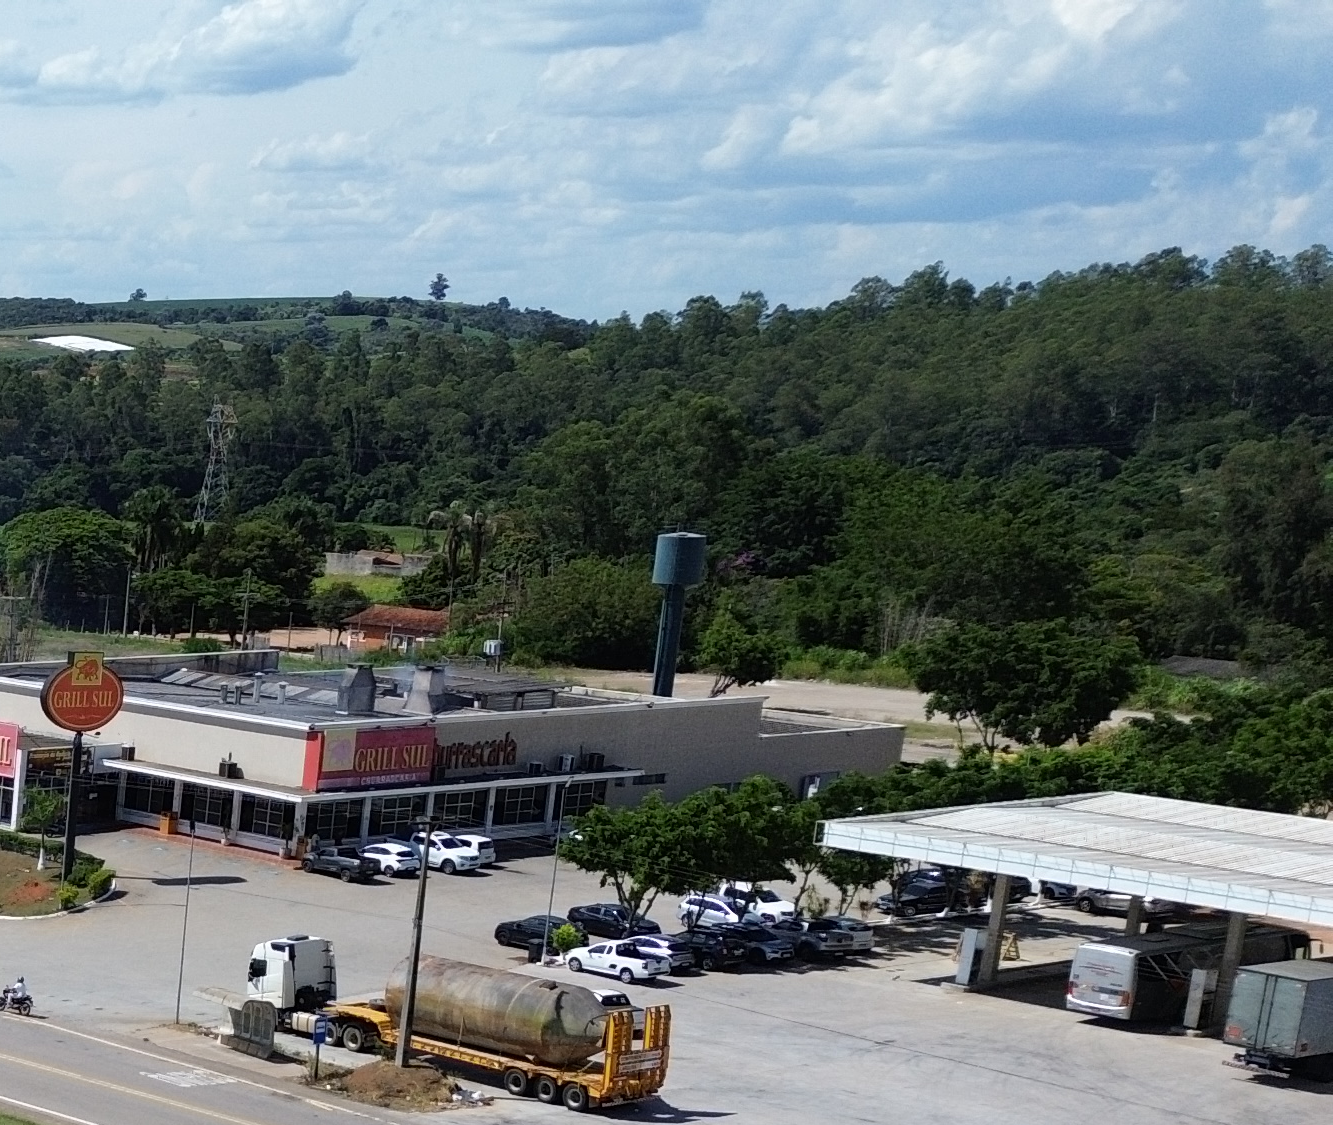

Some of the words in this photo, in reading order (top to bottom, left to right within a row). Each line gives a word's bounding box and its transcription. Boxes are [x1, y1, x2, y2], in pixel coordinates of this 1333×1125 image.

[54, 691, 90, 708] GRILL
[92, 690, 114, 707] SUL
[355, 747, 397, 773] GRILL
[402, 744, 431, 769] SUL
